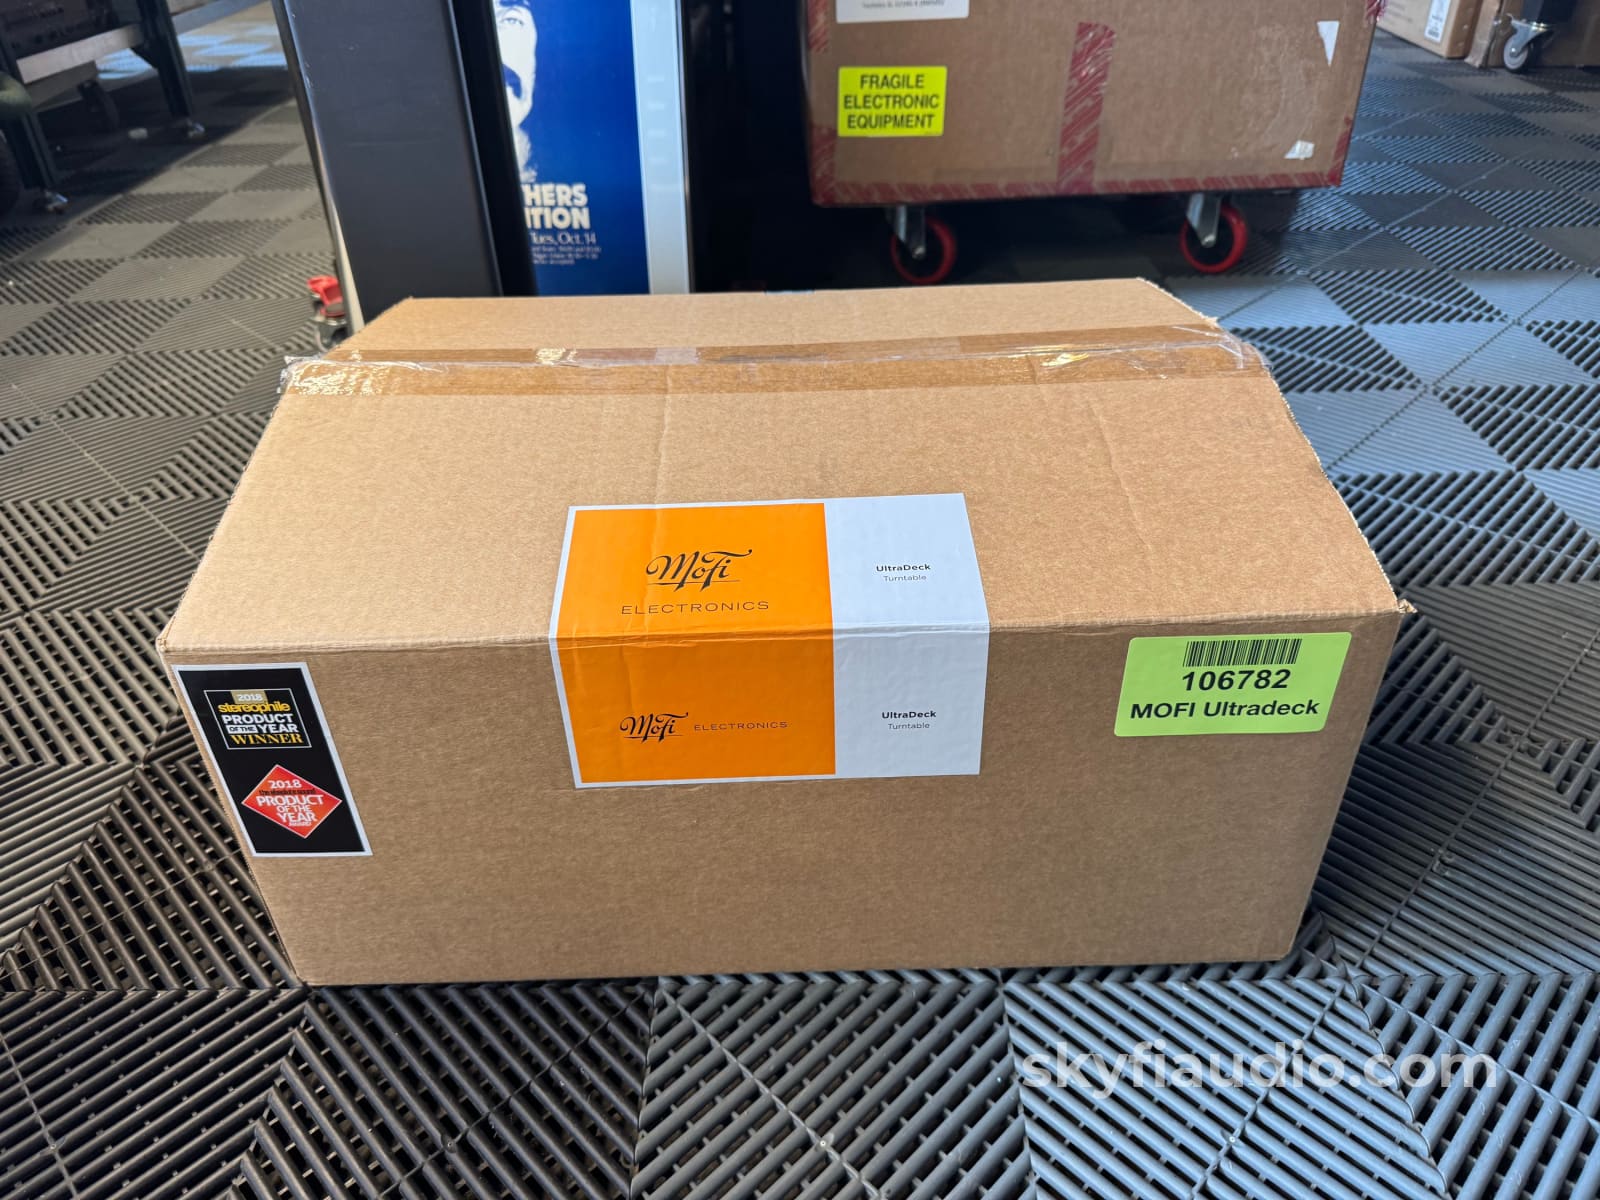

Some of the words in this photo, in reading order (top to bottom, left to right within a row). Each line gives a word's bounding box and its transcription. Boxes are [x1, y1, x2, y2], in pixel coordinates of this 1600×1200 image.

[860, 74, 925, 89] FRAGILE
[843, 94, 940, 110] ELECTRONIC
[847, 114, 935, 129] EQUIPMENT
[646, 549, 753, 592] MoFi
[876, 563, 932, 572] UltraDeck
[621, 601, 769, 615] ELECTRONICS
[1182, 669, 1291, 691] 106782
[238, 693, 263, 701] 2018
[218, 701, 291, 713] stereophile
[1130, 702, 1196, 719] MOFI
[1203, 699, 1320, 717] Ultradeck
[221, 714, 293, 724] PRODUCT
[881, 710, 937, 719] UltraDeck
[258, 724, 299, 733] YEAR
[619, 712, 689, 743] MoFi
[694, 721, 788, 731] ELECTRONICS
[888, 722, 930, 730] Turntable
[230, 733, 304, 744] WINNER
[268, 779, 301, 788] 2018
[256, 794, 324, 807] PRODUCT
[276, 805, 291, 813] OF
[293, 804, 313, 812] THE
[276, 812, 318, 822] YEAR
